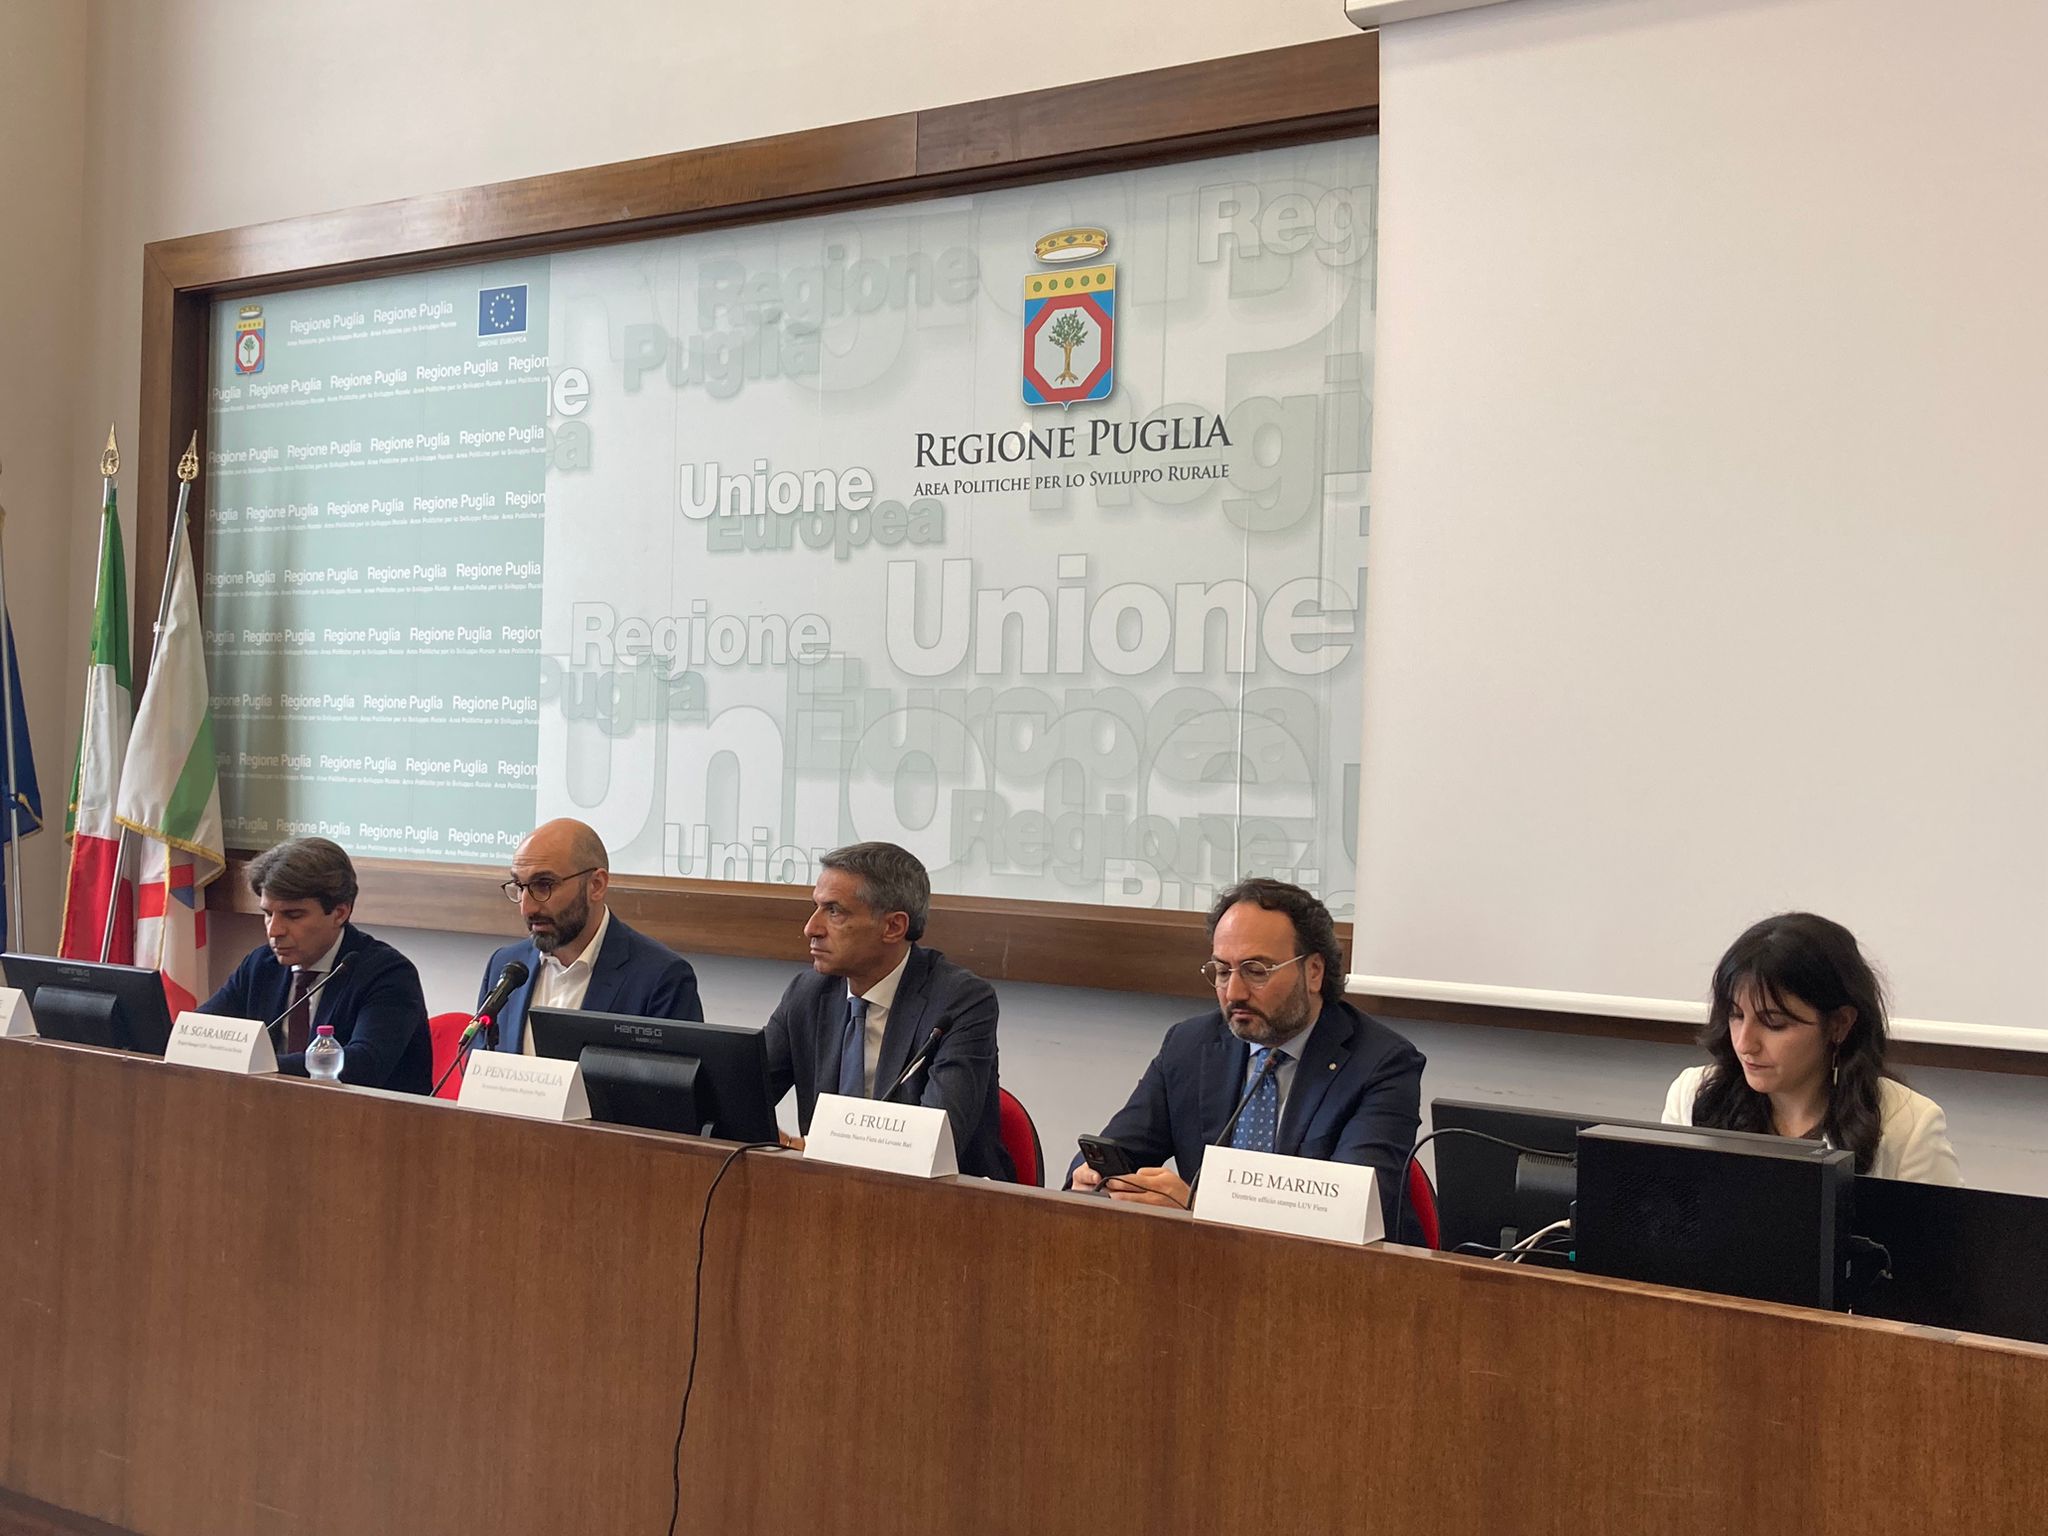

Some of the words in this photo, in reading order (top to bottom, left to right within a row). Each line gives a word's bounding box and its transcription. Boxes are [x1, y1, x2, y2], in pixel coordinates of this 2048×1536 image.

[290, 318, 331, 335] Regione
[333, 312, 364, 330] Puglia
[374, 305, 417, 324] Regione
[419, 301, 453, 320] Puglia
[249, 381, 289, 399] Regione
[291, 378, 322, 395] Puglia
[330, 372, 372, 391] Regione
[374, 369, 407, 386] Puglia
[416, 364, 461, 382] Regione
[464, 359, 498, 378] Puglia
[249, 447, 279, 463] Puglia
[287, 442, 327, 460] Regione
[330, 440, 362, 457] Puglia
[371, 436, 414, 454] Regione
[416, 432, 450, 450] Puglia
[459, 428, 505, 447] Regione
[508, 425, 544, 443] Puglia
[914, 426, 1075, 468] REGIONE
[1088, 414, 1233, 456] PUGLIA
[680, 458, 874, 520] Unione
[913, 482, 949, 496] AREA
[953, 477, 1030, 494] POLITICHE
[1035, 476, 1061, 490] PER
[1066, 473, 1085, 488] LO
[1089, 467, 1163, 487] SVILUPPO
[1168, 464, 1229, 481] RURALE
[246, 505, 285, 522] Regione
[288, 503, 319, 520] Puglia
[327, 501, 369, 517] Regione
[371, 498, 404, 515] Puglia
[413, 496, 458, 514] Regione
[460, 492, 495, 511] Puglia
[706, 497, 945, 560] Europea
[245, 570, 276, 587] Puglia
[284, 569, 325, 586] Regione
[327, 568, 359, 584] Puglia
[367, 565, 411, 583] Regione
[413, 564, 447, 582] Puglia
[456, 562, 503, 580] Regione
[505, 560, 541, 579] Puglia
[885, 553, 1357, 678] Unione
[243, 629, 283, 645] Regione
[284, 628, 316, 645] Puglia
[324, 628, 366, 645] Regione
[368, 627, 401, 644] Puglia
[410, 626, 455, 644] Regione
[457, 626, 492, 644] Puglia
[571, 599, 832, 682] Regione
[280, 694, 321, 711] Regione
[323, 694, 355, 711] Puglia
[363, 695, 407, 712] Regione
[409, 695, 443, 713] Puglia
[452, 695, 499, 713] Regione
[501, 696, 537, 714] Puglia
[239, 752, 278, 769] Regione
[281, 754, 312, 771] Puglia
[320, 755, 361, 772] Regione
[364, 756, 397, 774] Puglia
[406, 757, 451, 775] Regione
[453, 759, 488, 777] Puglia
[276, 818, 317, 836] Regione
[319, 820, 351, 838] Puglia
[359, 823, 403, 841] Regione
[405, 825, 439, 844] Puglia
[448, 827, 494, 846] Regione
[191, 1026, 248, 1043] SGARAMELLA
[485, 1065, 562, 1087] PENTASSUGLIA
[845, 1112, 857, 1126] G.
[860, 1114, 906, 1133] FRULLI
[1227, 1169, 1236, 1184] I.
[1241, 1171, 1264, 1187] DE
[1267, 1174, 1340, 1198] MARINIS
